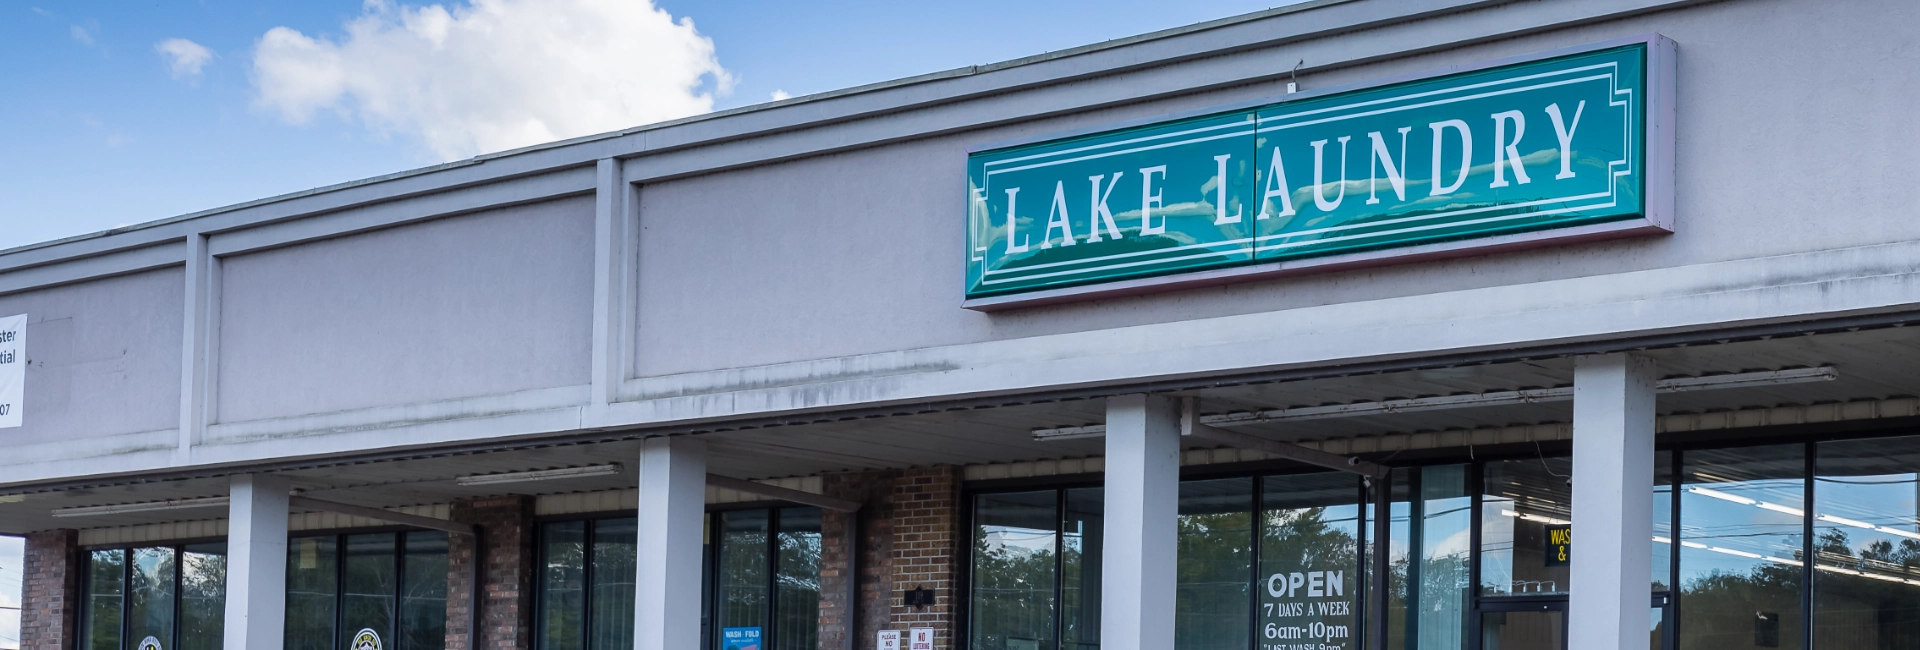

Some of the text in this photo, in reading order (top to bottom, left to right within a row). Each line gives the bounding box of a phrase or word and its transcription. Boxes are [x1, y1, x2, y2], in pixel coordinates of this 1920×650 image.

[1004, 99, 1587, 254] LAKE LAUNDRY
[1551, 529, 1570, 545] WAS
[1558, 546, 1566, 561] &
[1268, 570, 1343, 598] OPEN
[1263, 601, 1350, 617] 7 DAYS A WEEK
[725, 630, 742, 638] WASH
[745, 630, 760, 638] FOLD
[918, 632, 926, 642] NO
[1264, 621, 1349, 643] 6am-10pm
